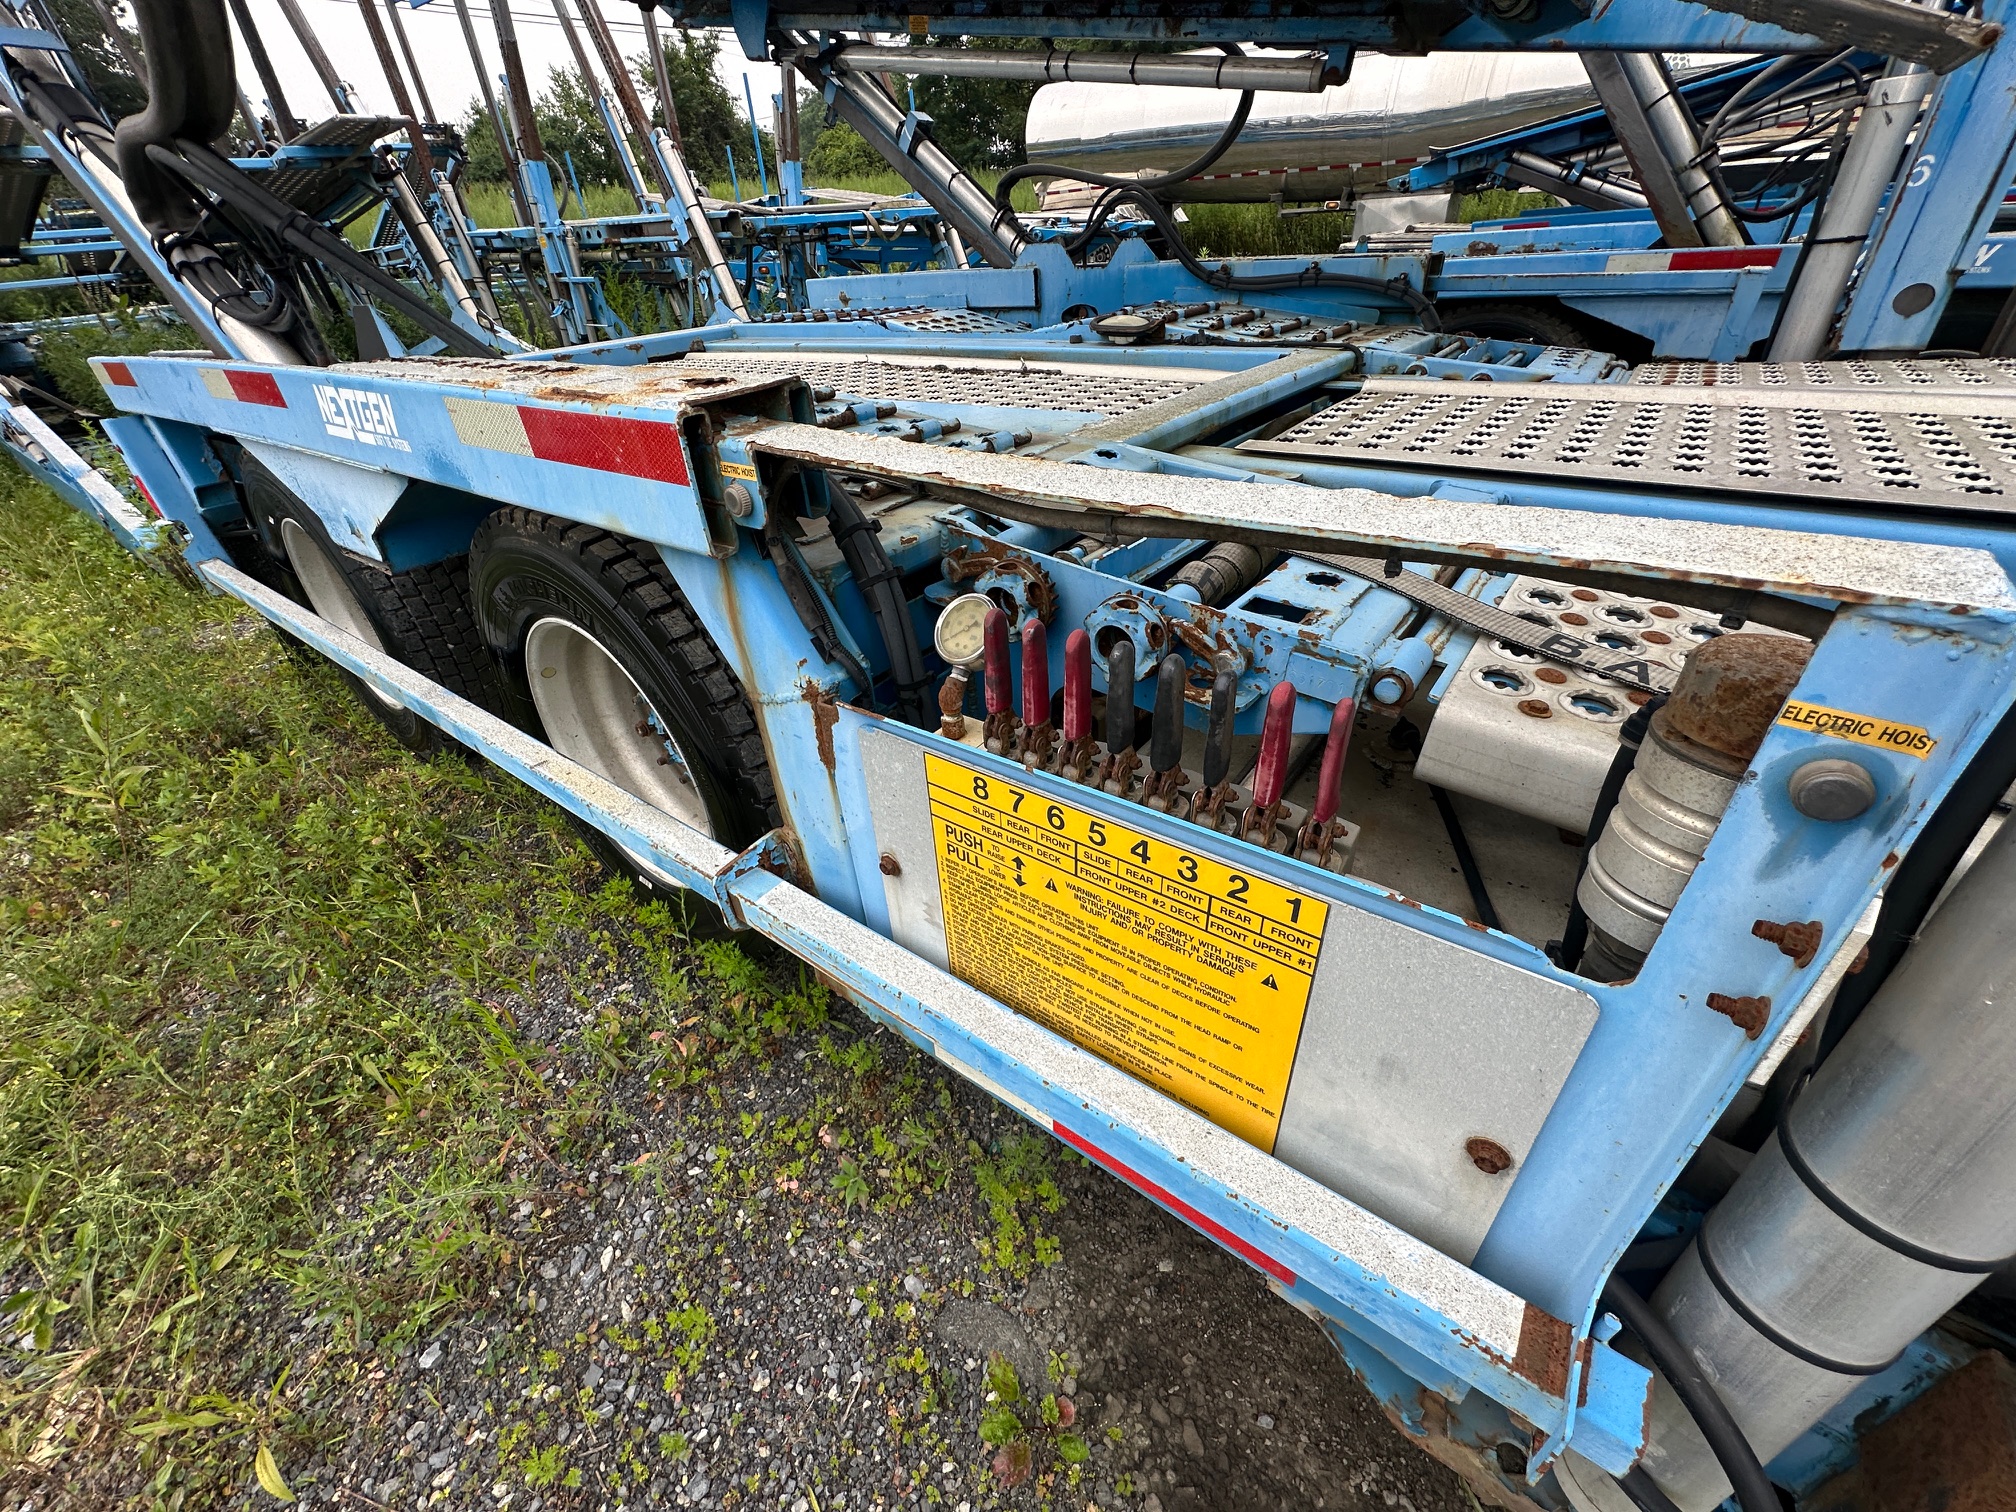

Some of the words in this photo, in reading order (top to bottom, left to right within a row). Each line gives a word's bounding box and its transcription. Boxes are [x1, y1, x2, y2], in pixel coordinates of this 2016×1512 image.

[1906, 154, 1935, 188] 6
[312, 384, 399, 442] NEXTGEN
[1781, 705, 1874, 737] ELECTRIC
[1878, 726, 1938, 754] HOIST
[945, 823, 983, 852] PUSH
[946, 842, 984, 870] PULL
[973, 776, 988, 800] 8
[1008, 788, 1024, 813] 7
[1046, 805, 1065, 830] 6
[1087, 820, 1106, 846] 5
[1130, 839, 1151, 864] 4
[1176, 855, 1198, 882] 3
[1226, 874, 1249, 904] 2
[1285, 897, 1301, 923] 1
[981, 824, 1003, 839] REAR
[1006, 835, 1033, 852] UPPER
[1036, 848, 1061, 864] DECK
[986, 849, 1005, 862] RAISE
[991, 843, 999, 852] TO
[972, 805, 995, 820] SLIDE
[1006, 819, 1029, 834] REAR
[1040, 833, 1070, 850] FRONT
[1083, 850, 1111, 868] SLIDE
[1125, 867, 1153, 885] REAR
[1166, 884, 1203, 904] FRONT
[1220, 905, 1251, 925] REAR
[1270, 926, 1313, 949] FRONT
[988, 867, 1006, 880] LOWER
[992, 863, 1000, 871] TO
[1079, 866, 1111, 885] FRONT
[1115, 881, 1147, 901] UPPER
[1152, 897, 1165, 909] #2
[1170, 904, 1199, 923] DECK
[1065, 881, 1103, 903] WARNING:
[1106, 899, 1140, 919] FAILURE
[1143, 914, 1155, 925] TO
[1158, 922, 1194, 942] COMPLY
[1198, 938, 1221, 955] WITH
[1225, 950, 1257, 970] THESE
[1073, 892, 1131, 923] INSTRUCTIONS
[1134, 919, 1151, 931] MAY
[1154, 928, 1187, 947] RESULT
[1190, 944, 1199, 953] IN
[1202, 949, 1244, 973] SERIOUS
[1079, 902, 1107, 920] INJURY
[1110, 917, 1143, 937] AND/OR
[1146, 932, 1193, 958] PROPERTY
[1196, 954, 1235, 978] DAMAGE
[1210, 920, 1248, 942] FRONT
[1252, 938, 1292, 961] UPPER
[1297, 957, 1311, 969] #1
[1109, 945, 1141, 965] MOVEABLE
[1142, 961, 1170, 979] OBJECTS
[1172, 975, 1192, 989] WHILE
[1193, 984, 1230, 1007] HYDRAULIC
[1136, 951, 1161, 968] PROPER
[1162, 963, 1198, 985] OPERATING
[1122, 1005, 1139, 1018] WHEN
[1140, 1014, 1153, 1025] NOT
[1126, 965, 1138, 976] ARE
[1139, 972, 1159, 986] CLEAR
[1171, 987, 1193, 1002] DECKS
[1194, 998, 1221, 1015] BEFORE
[1222, 1011, 1260, 1034] OPERATING
[1131, 992, 1159, 1010] DESCEND
[1160, 1006, 1178, 1020] FROM
[1179, 1016, 1192, 1027] THE
[1193, 1023, 1211, 1036] HEAD
[1212, 1032, 1231, 1046] RAMP
[1113, 1012, 1136, 1028] FRAYING
[1148, 1030, 1175, 1048] SHOWING
[1177, 1045, 1196, 1059] SIGNS
[1208, 1061, 1243, 1083] EXCESSIVE
[1132, 1038, 1160, 1057] STRAIGHT
[1161, 1054, 1175, 1065] LINE
[1175, 1061, 1193, 1075] FROM
[1194, 1071, 1207, 1082] THE
[1208, 1078, 1233, 1096] SPINDLE
[1245, 1098, 1259, 1110] THE
